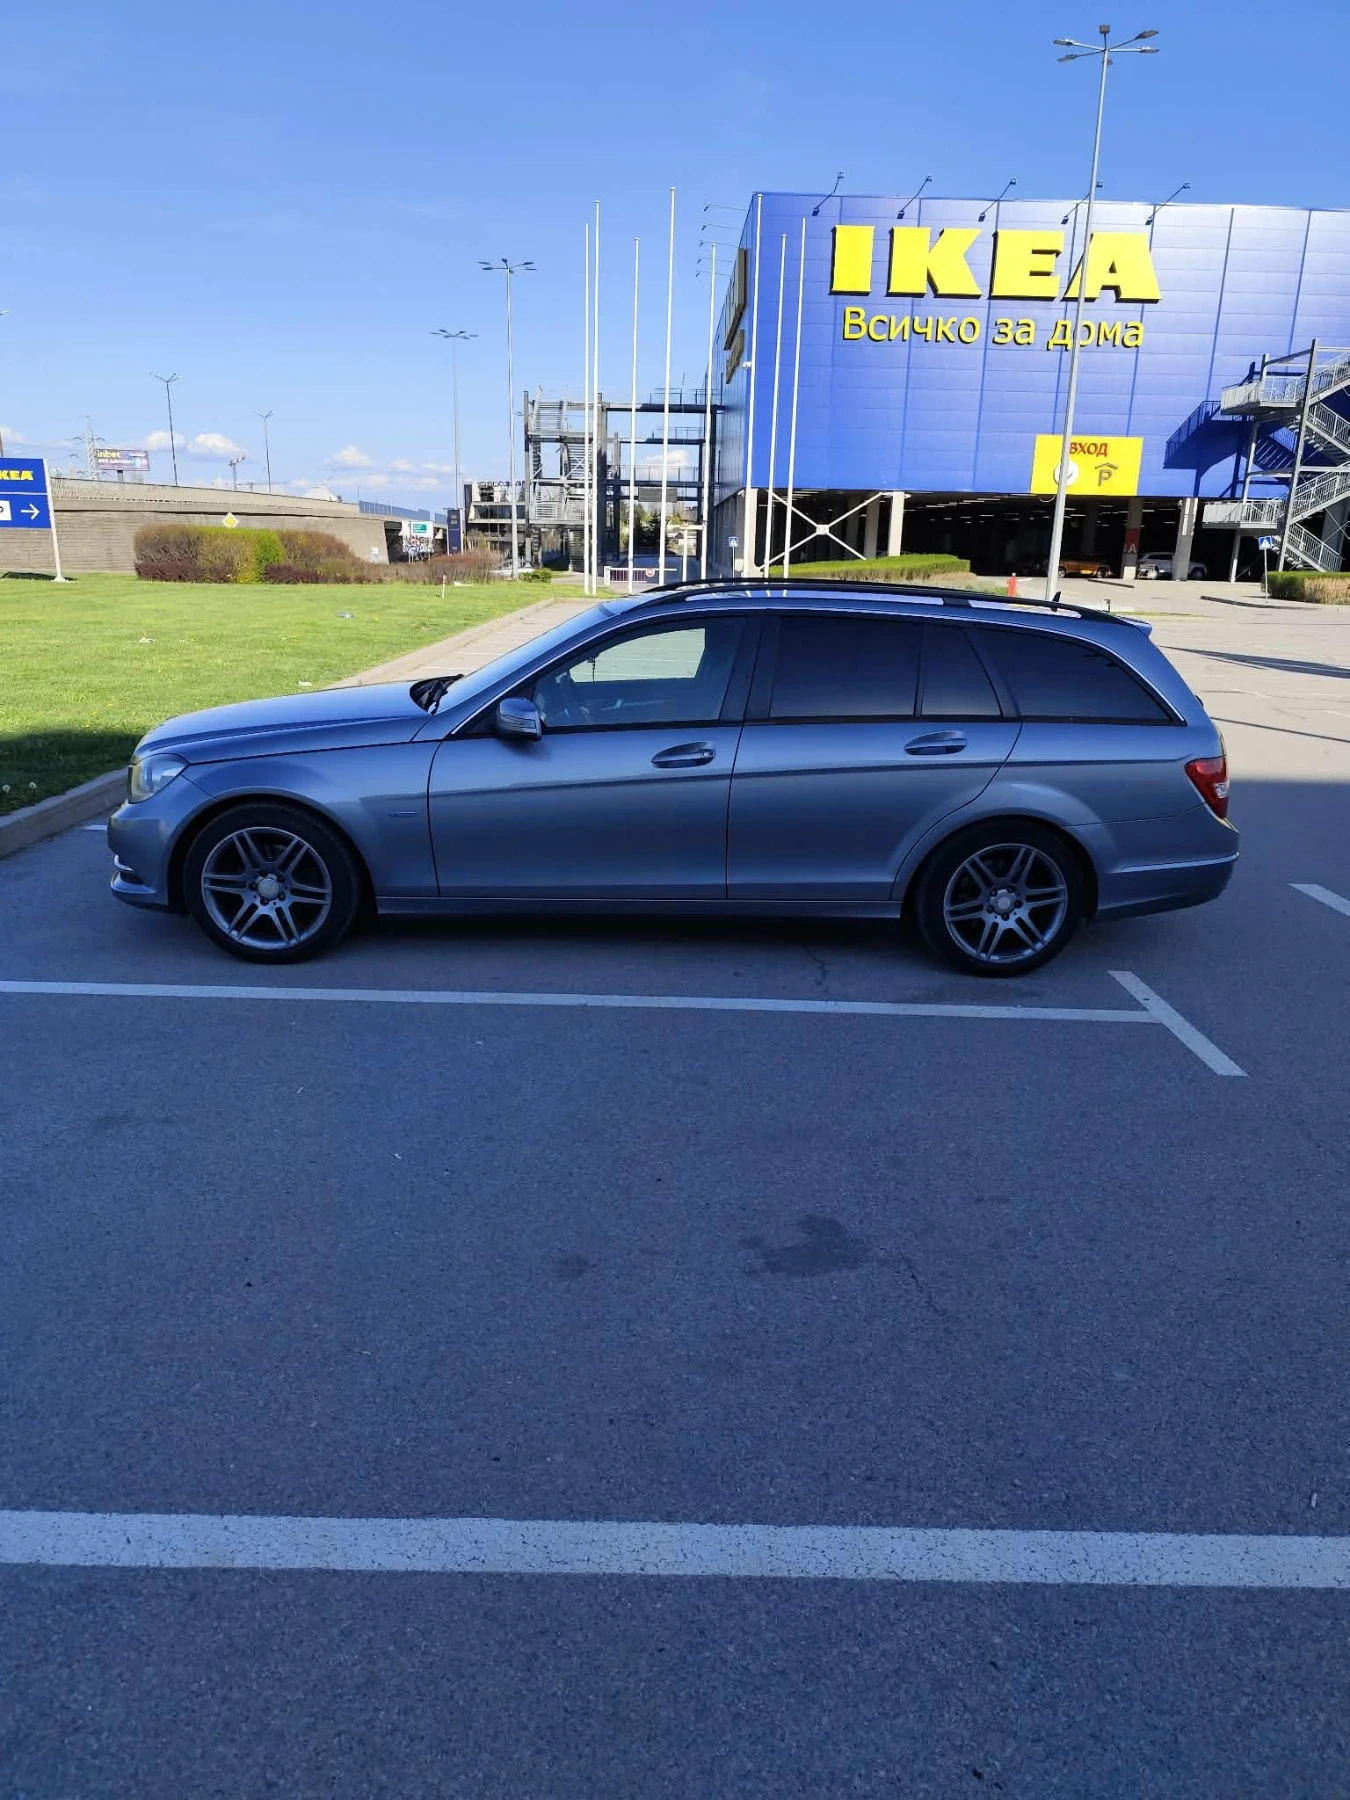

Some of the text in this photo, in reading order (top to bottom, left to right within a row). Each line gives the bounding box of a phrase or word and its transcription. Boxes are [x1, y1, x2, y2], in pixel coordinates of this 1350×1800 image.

[831, 225, 1161, 302] IKEA
[843, 307, 1145, 351] Всичко за дома
[0, 470, 34, 481] KEA
